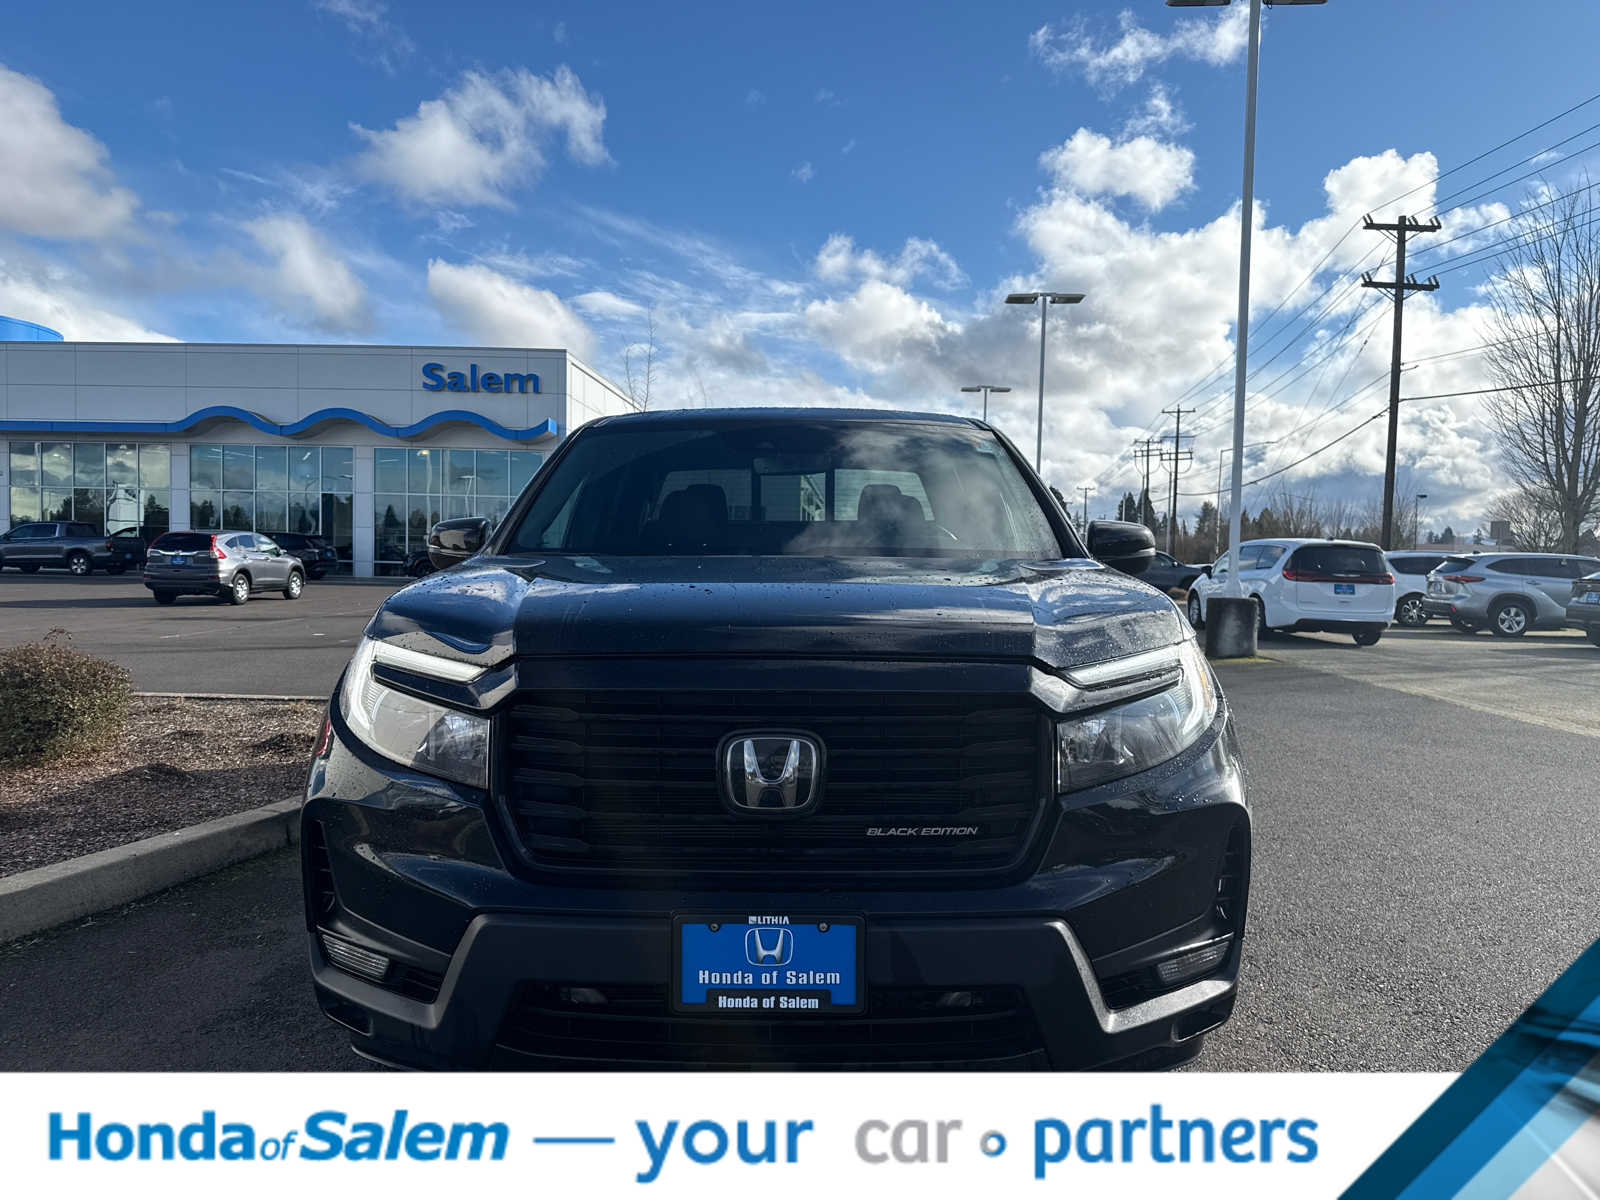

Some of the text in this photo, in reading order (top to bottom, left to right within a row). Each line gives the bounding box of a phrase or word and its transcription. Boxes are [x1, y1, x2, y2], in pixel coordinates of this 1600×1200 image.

[422, 362, 541, 393] Salem
[866, 826, 978, 836] BLACK EDITION
[757, 915, 790, 925] LITHIA
[699, 970, 841, 985] Honda of Salem
[718, 996, 819, 1009] Honda of Salem
